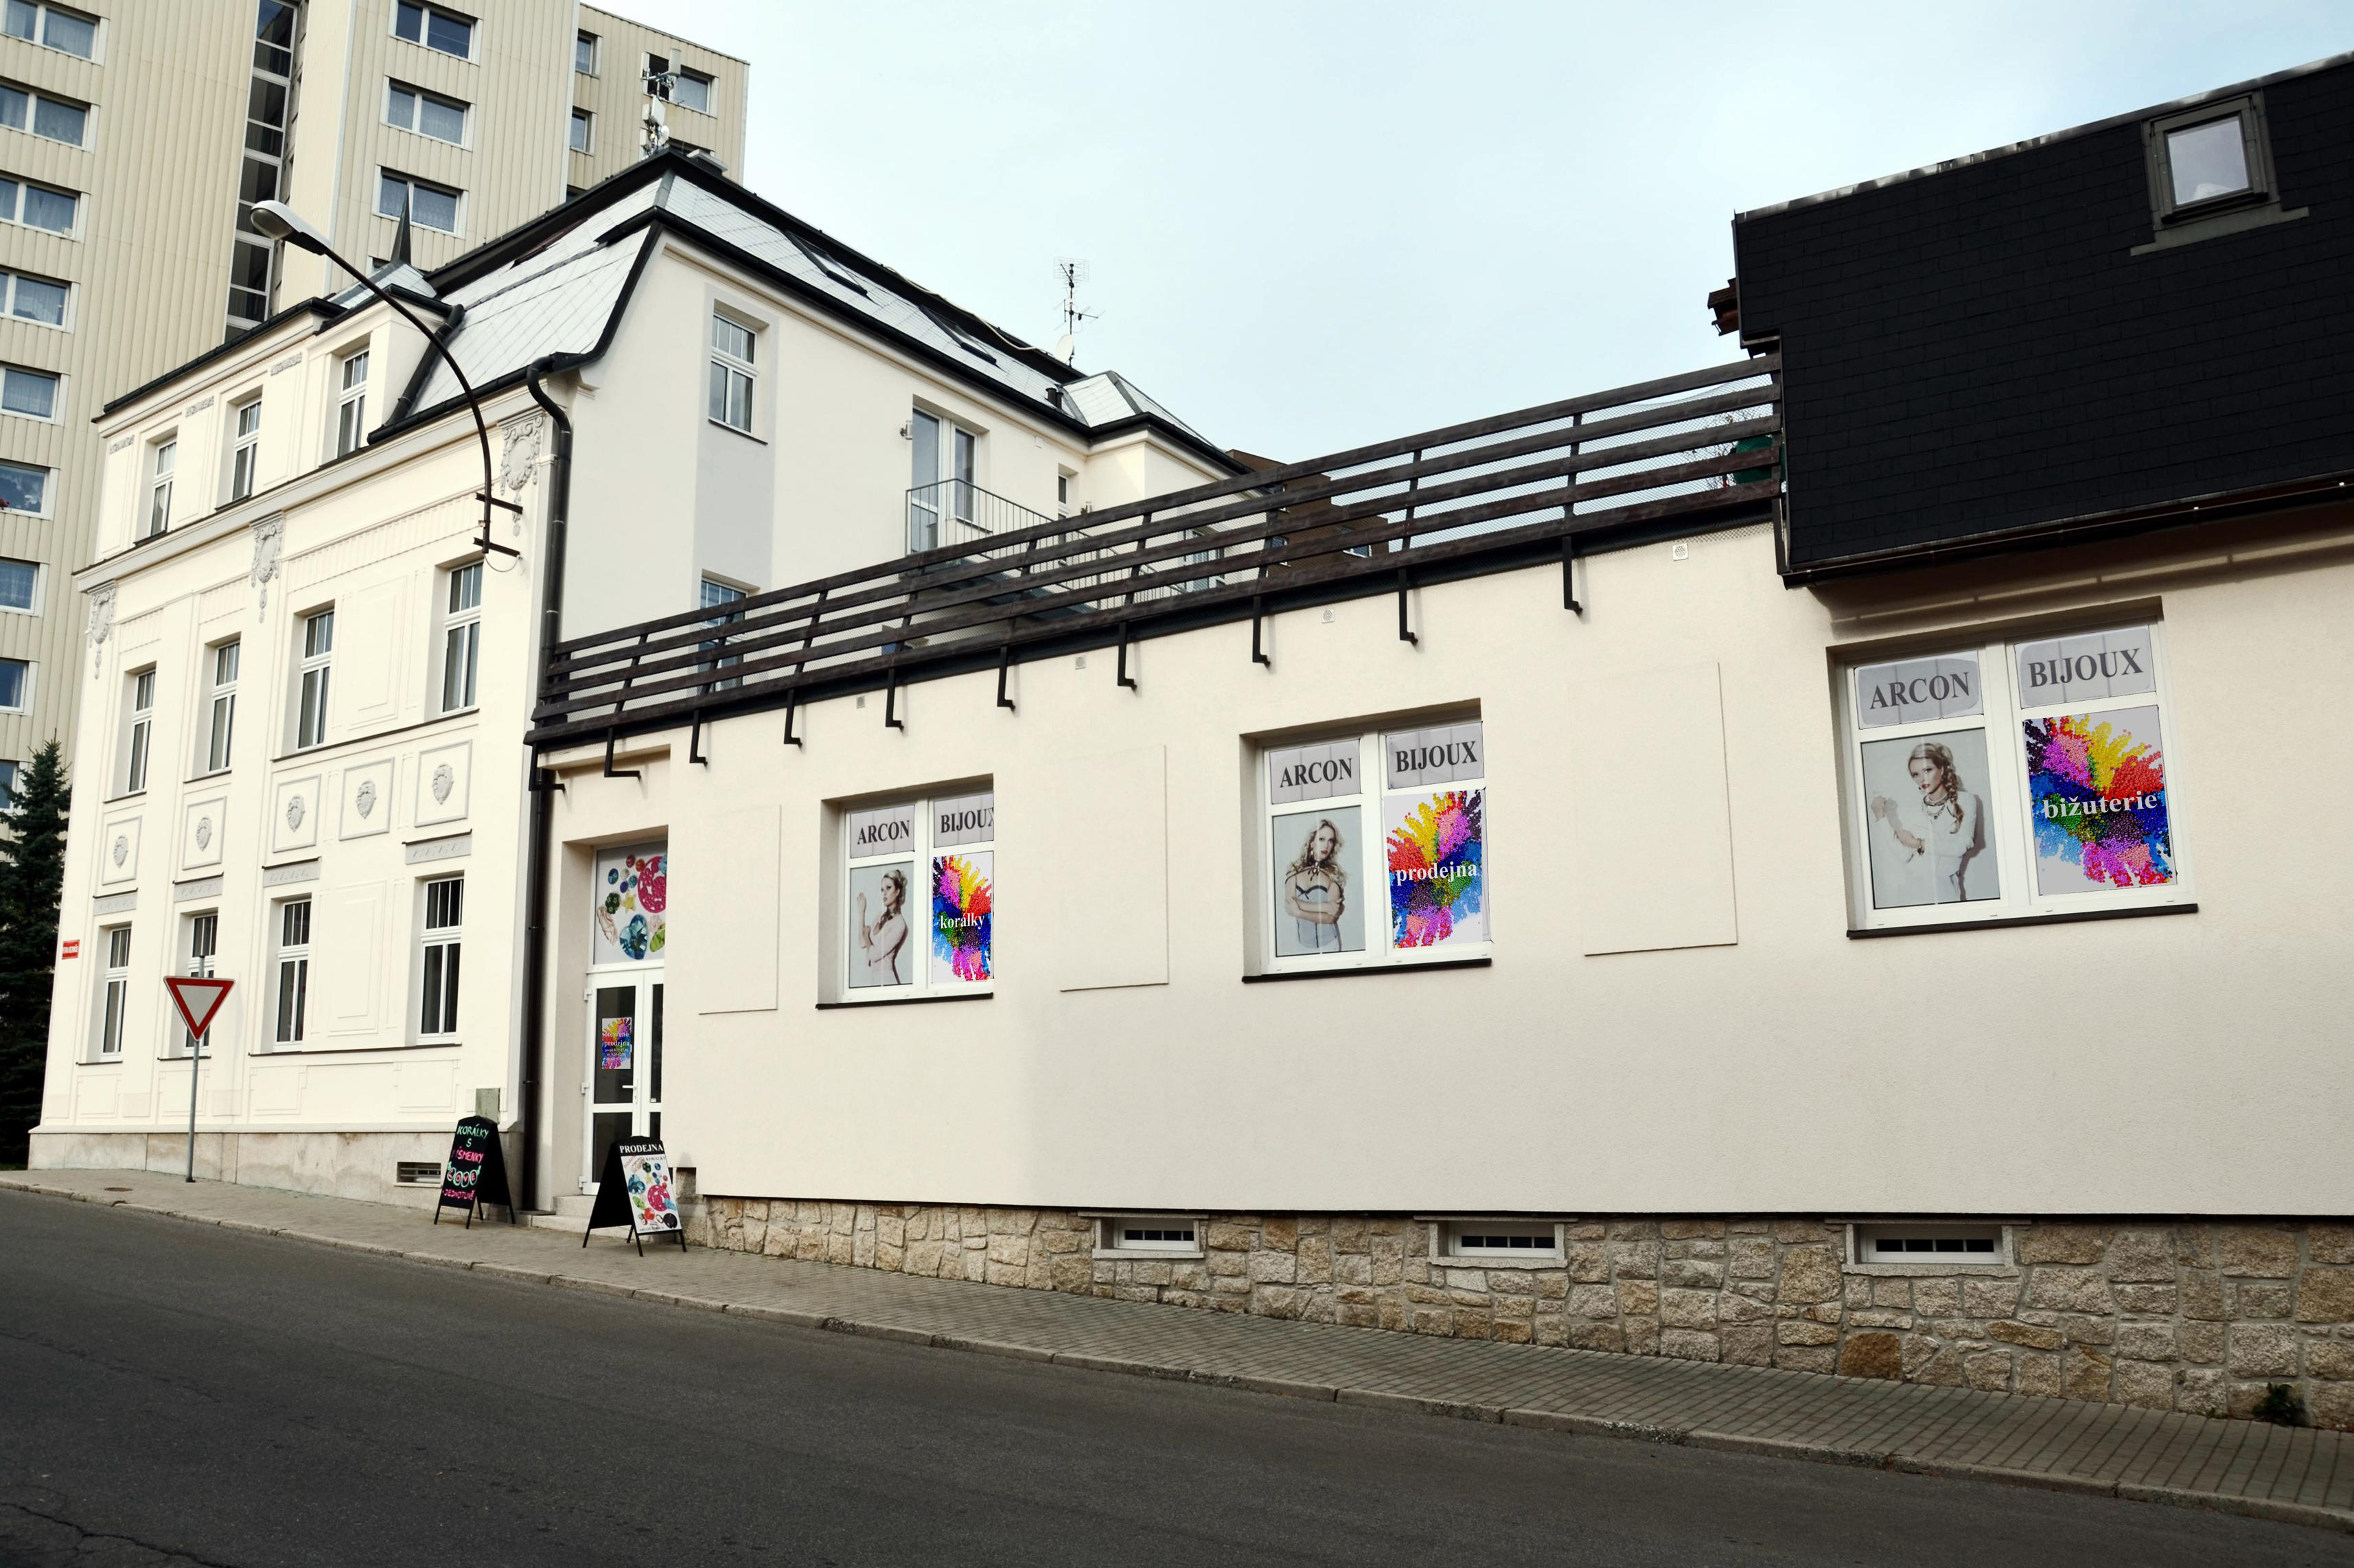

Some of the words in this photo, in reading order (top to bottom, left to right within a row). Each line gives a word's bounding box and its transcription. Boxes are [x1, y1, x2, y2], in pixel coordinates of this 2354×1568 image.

[1869, 671, 1971, 710] ARCON
[2028, 648, 2144, 688] BIJOUX
[1280, 757, 1353, 788] ARCON
[1395, 741, 1478, 773] BIJOUX
[2042, 790, 2158, 820] bižuterie
[857, 820, 910, 845] ARCON
[1396, 861, 1478, 886] prodejna
[941, 912, 985, 930] korálky
[604, 1039, 630, 1048] prodejna
[457, 1123, 489, 1139] KORÁLKY
[619, 1143, 664, 1153] PRODEJNA
